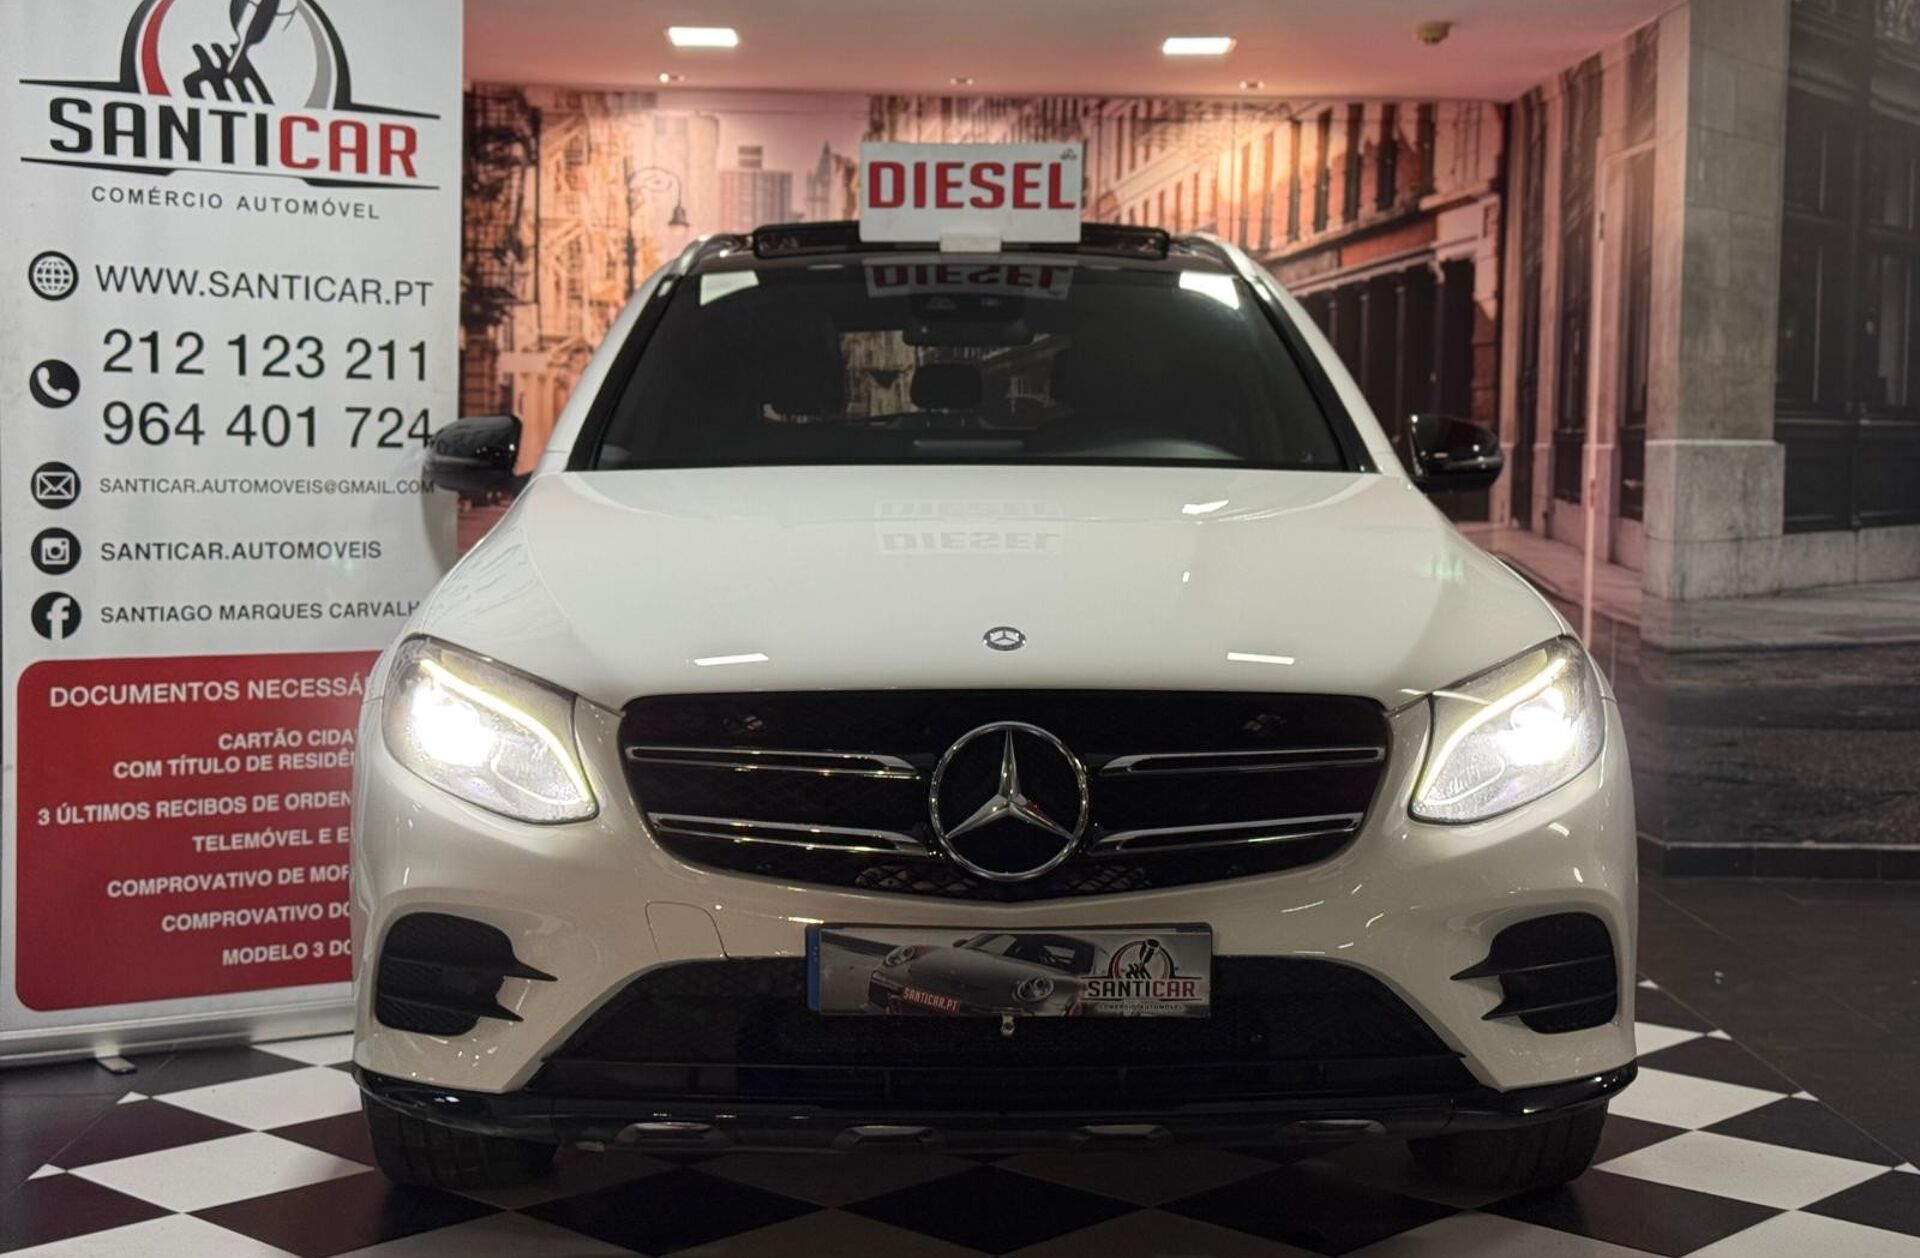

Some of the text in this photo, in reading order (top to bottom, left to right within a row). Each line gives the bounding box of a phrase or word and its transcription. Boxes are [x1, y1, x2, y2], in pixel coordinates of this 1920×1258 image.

[50, 97, 417, 178] SANTICAR
[868, 161, 1076, 209] DIESEL
[92, 185, 380, 219] COMÉRCIO AUTOMÓVEL
[95, 264, 434, 307] WWW.SANTICAR.PT
[103, 328, 427, 381] 212 123 211
[103, 401, 433, 448] 964 401 724
[99, 478, 435, 495] SANTICAR.AUTOMOVEIS@GMAIL.COM
[101, 541, 382, 561] SANTICAR.AUTOMOVEIS
[101, 605, 212, 624] SANTIAGO
[219, 602, 323, 621] MARQUES
[50, 672, 368, 708] DOCUMENTOS NECESSÁ
[218, 728, 358, 750] CARTÃO CIDA
[114, 747, 354, 778] COM TÍTULO DE RESIDÊ
[38, 807, 50, 826] 3
[57, 802, 150, 824] ÚLTIMOS
[156, 796, 245, 819] RECIBOS
[252, 793, 280, 813] DE
[192, 827, 313, 852] TELEMÓVEL
[318, 827, 332, 844] E
[107, 869, 273, 898] COMPROVATIVO
[278, 867, 305, 885] DE
[162, 903, 323, 931] COMPROVATIVO
[222, 942, 308, 966] MODELO
[312, 941, 324, 958] 3
[1088, 981, 1195, 997] SANTICAR
